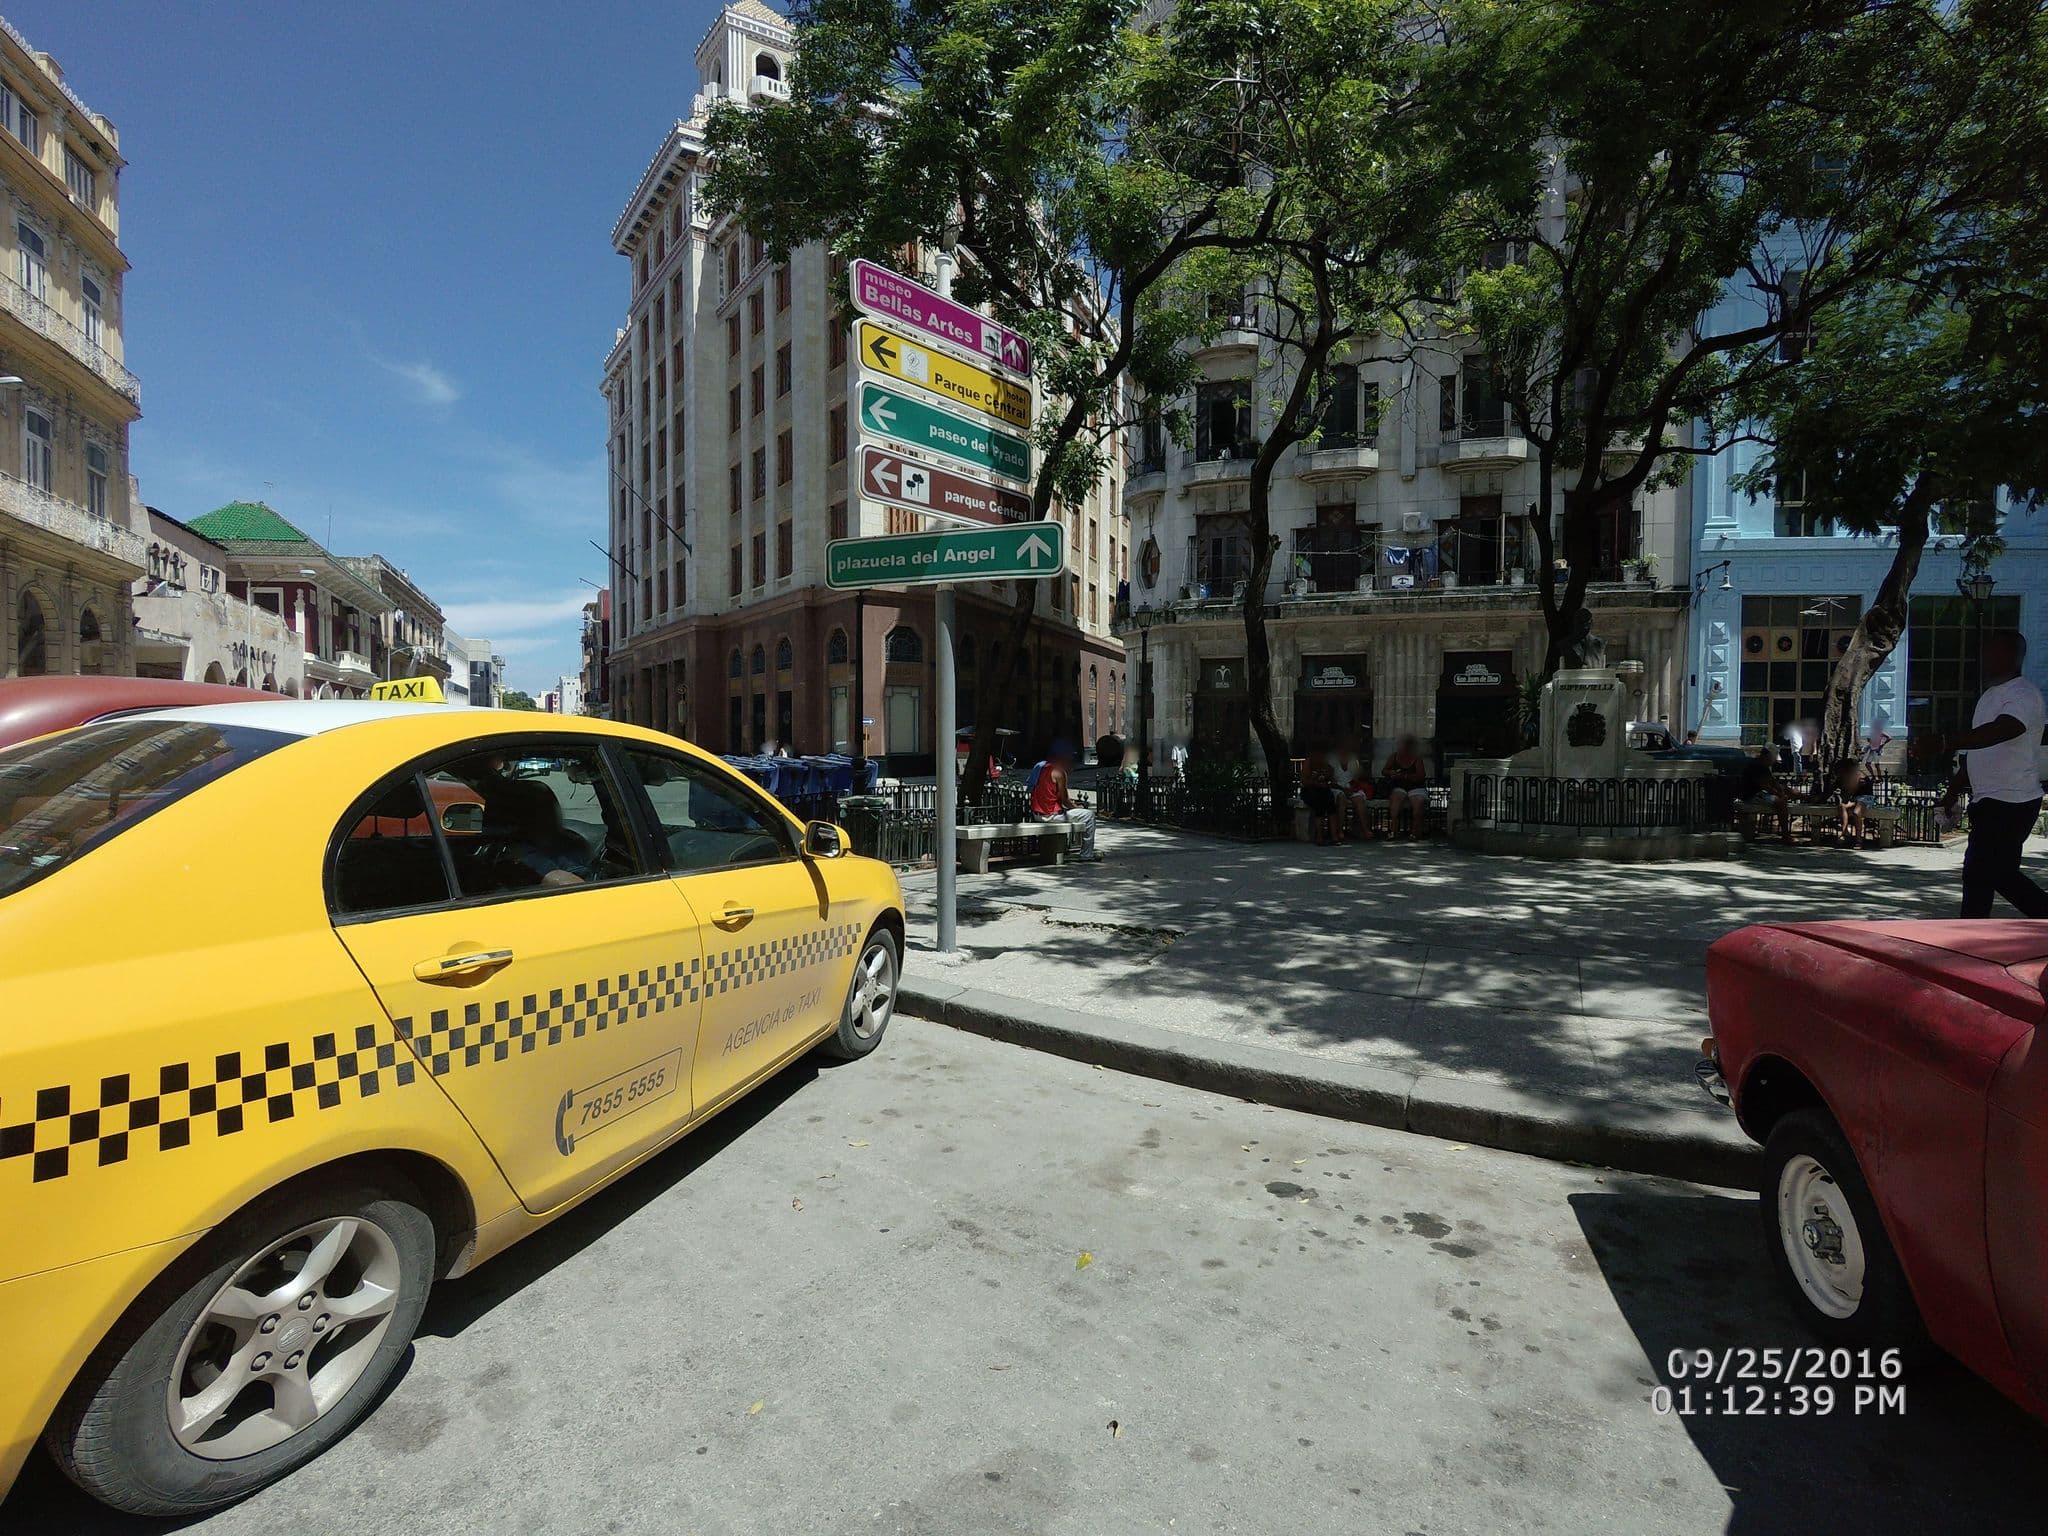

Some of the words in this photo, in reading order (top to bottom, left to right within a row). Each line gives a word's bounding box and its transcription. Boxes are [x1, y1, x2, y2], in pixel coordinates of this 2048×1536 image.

[864, 271, 912, 299] museo
[865, 284, 922, 322] Bellas
[927, 312, 973, 344] Artes
[934, 372, 980, 402] Parque
[984, 393, 1026, 420] Central
[1006, 390, 1026, 405] hotel
[929, 424, 968, 447] paseo
[970, 438, 989, 455] del
[992, 444, 1025, 468] Prado
[944, 489, 986, 512] parque
[989, 501, 1027, 521] Central
[836, 554, 905, 574] plazuela
[911, 551, 938, 565] del
[944, 546, 996, 565] Angel
[376, 681, 425, 701] TAXI
[722, 1008, 780, 1057] AGENCIA
[782, 1001, 796, 1023] de
[799, 986, 823, 1013] TAXI
[580, 1088, 623, 1125] 7855
[627, 1068, 666, 1102] 5555
